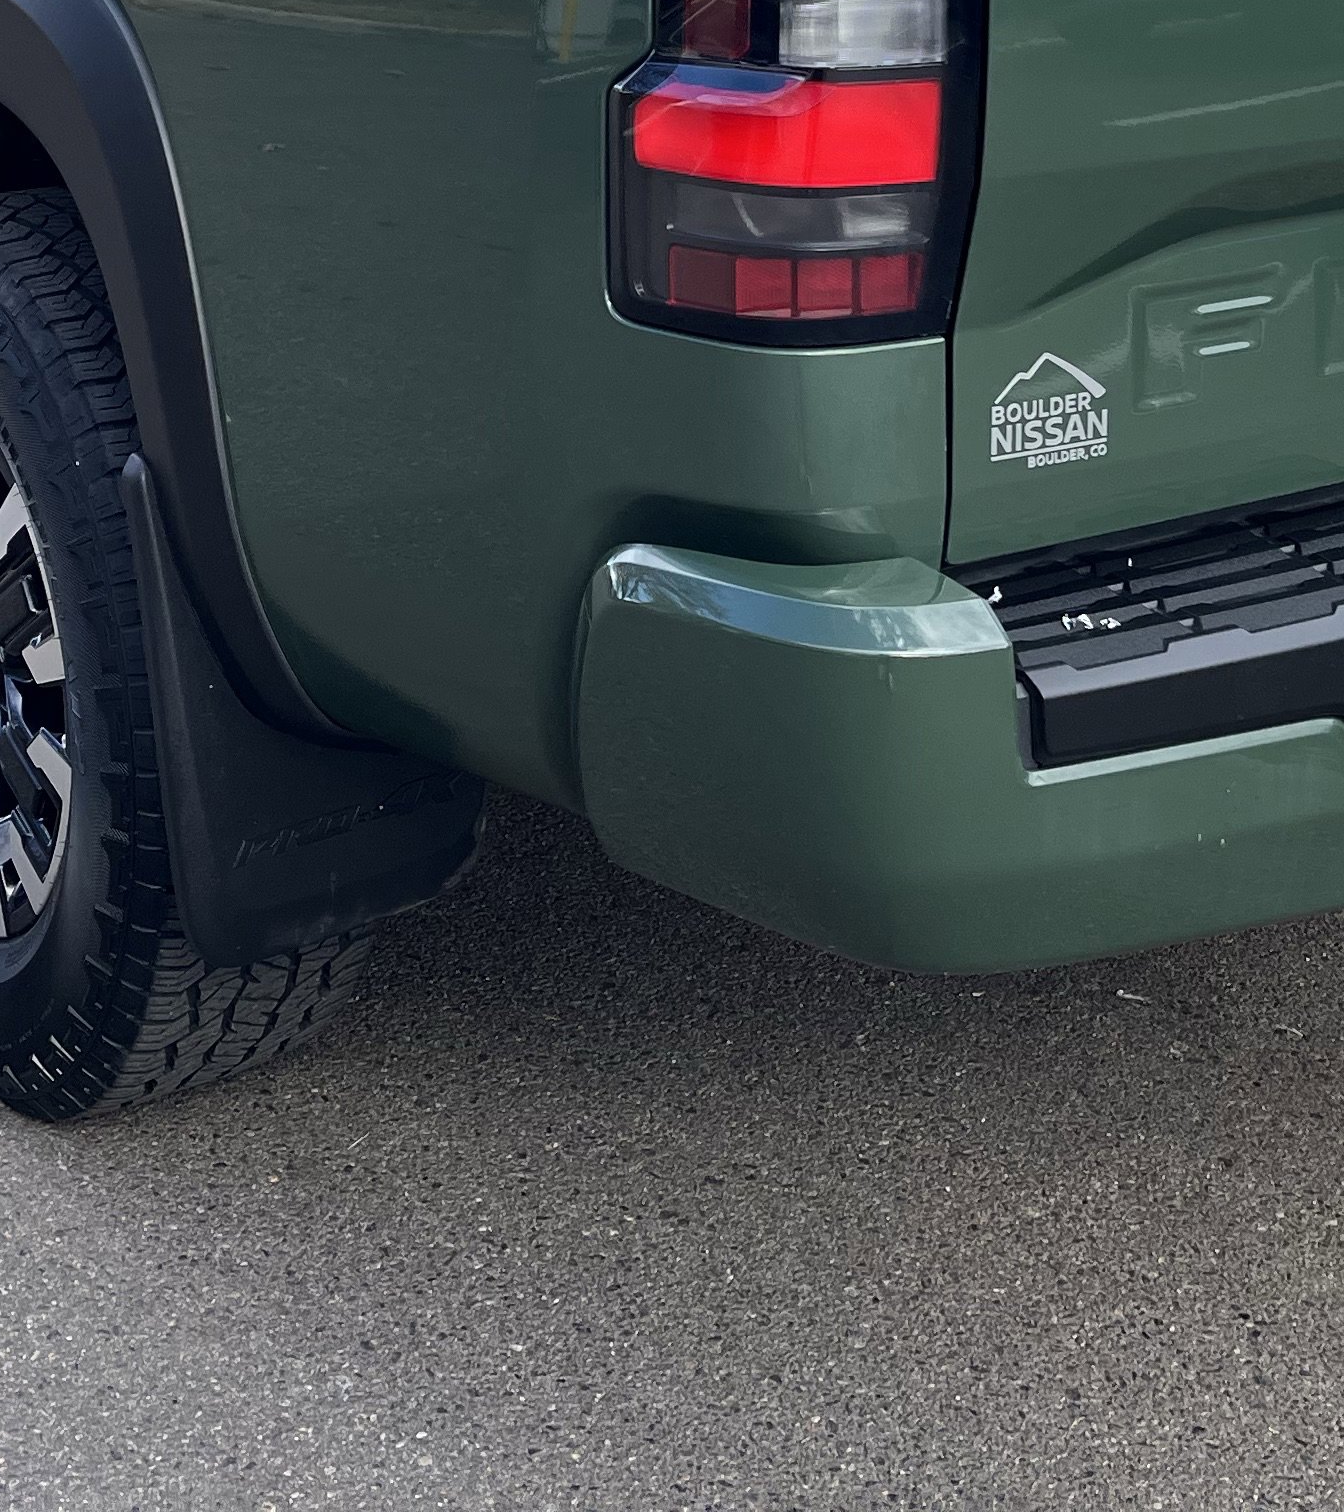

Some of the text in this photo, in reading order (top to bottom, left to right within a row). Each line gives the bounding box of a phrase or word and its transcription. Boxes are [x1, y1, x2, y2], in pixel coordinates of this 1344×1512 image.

[991, 391, 1092, 426] BOULDER
[990, 408, 1108, 456] NISSAN
[1027, 443, 1108, 469] BOULDER, CO
